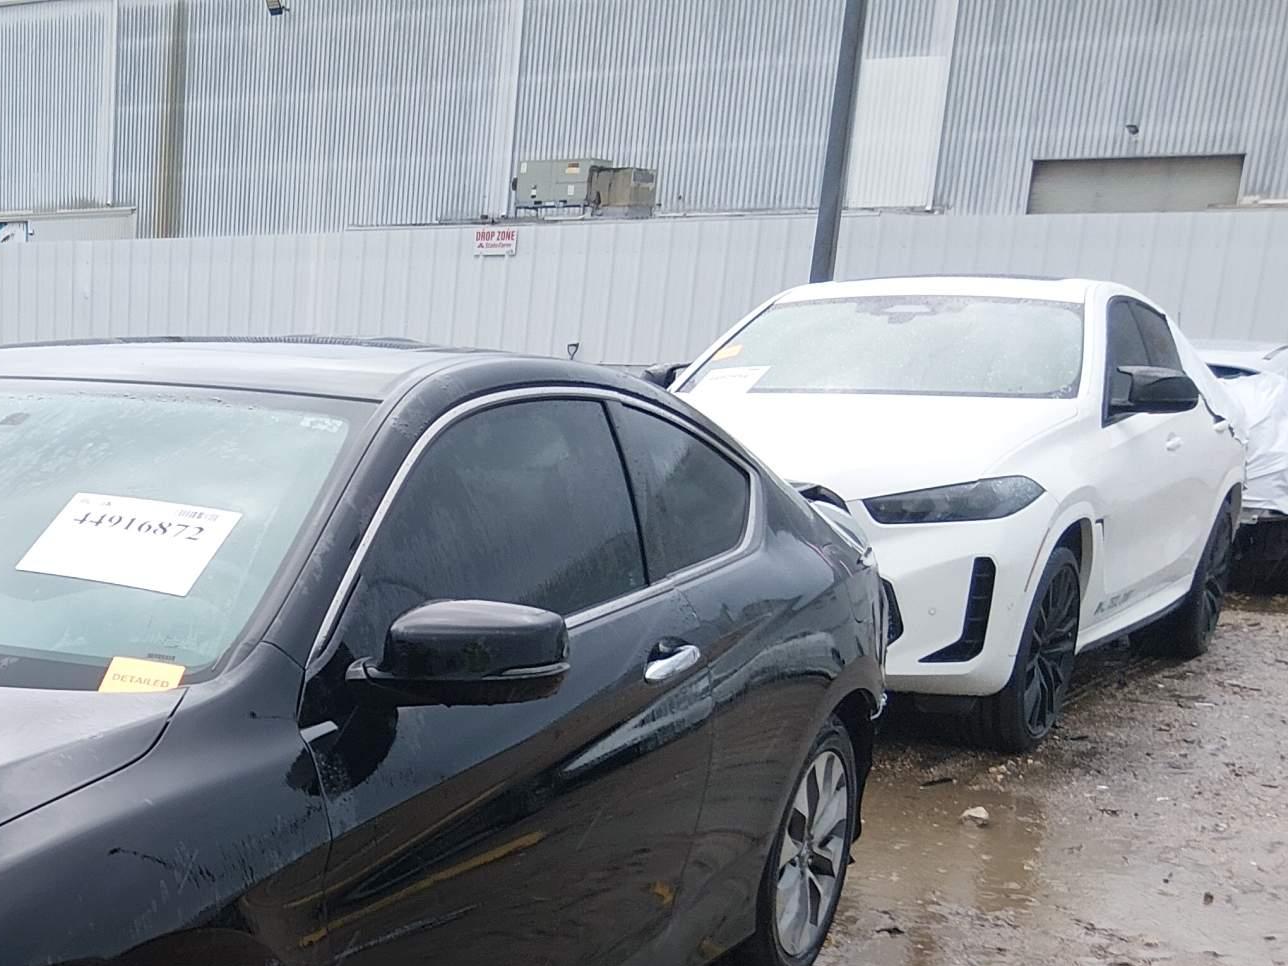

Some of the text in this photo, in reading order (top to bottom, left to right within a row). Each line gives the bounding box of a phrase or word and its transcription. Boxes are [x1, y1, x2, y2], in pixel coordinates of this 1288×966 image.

[476, 230, 516, 241] DROP ZONE
[73, 512, 205, 541] 44916872
[112, 673, 170, 688] DETAILED
